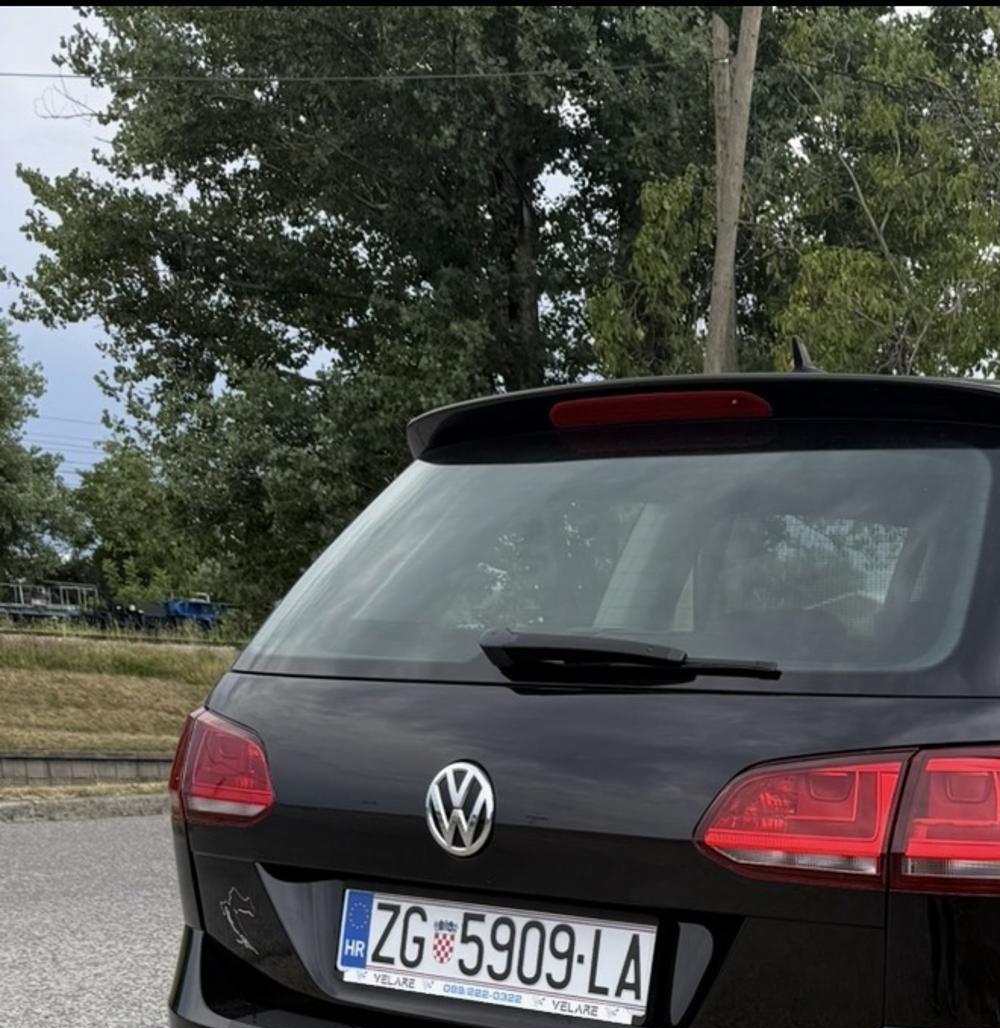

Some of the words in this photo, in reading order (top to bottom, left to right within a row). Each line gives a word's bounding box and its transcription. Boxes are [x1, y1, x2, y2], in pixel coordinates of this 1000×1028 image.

[427, 763, 493, 855] VW
[371, 903, 428, 968] ZG
[344, 939, 366, 958] HR
[373, 973, 416, 989] VELARE
[551, 999, 598, 1016] VELARE
